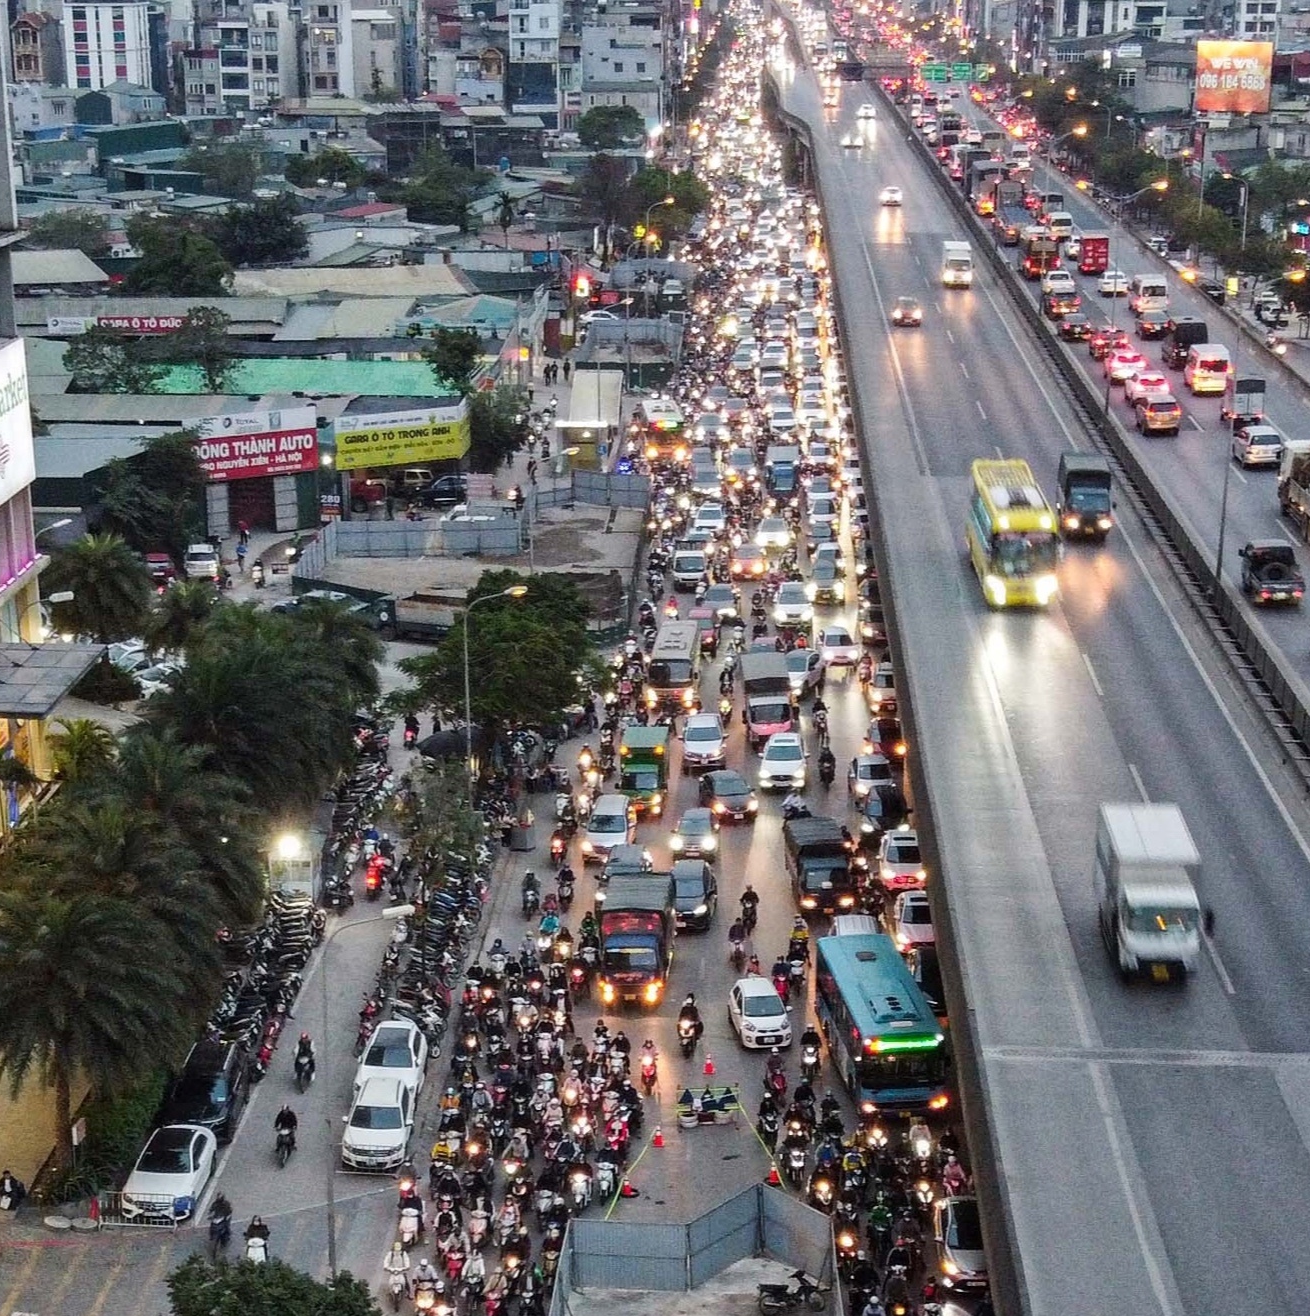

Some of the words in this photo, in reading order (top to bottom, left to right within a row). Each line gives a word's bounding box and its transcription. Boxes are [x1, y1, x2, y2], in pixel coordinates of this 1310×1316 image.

[1210, 57, 1231, 69] WE
[232, 436, 276, 456] THÀNH
[279, 434, 313, 451] AUTO
[275, 454, 287, 464] HÀ
[321, 495, 340, 503] 280
